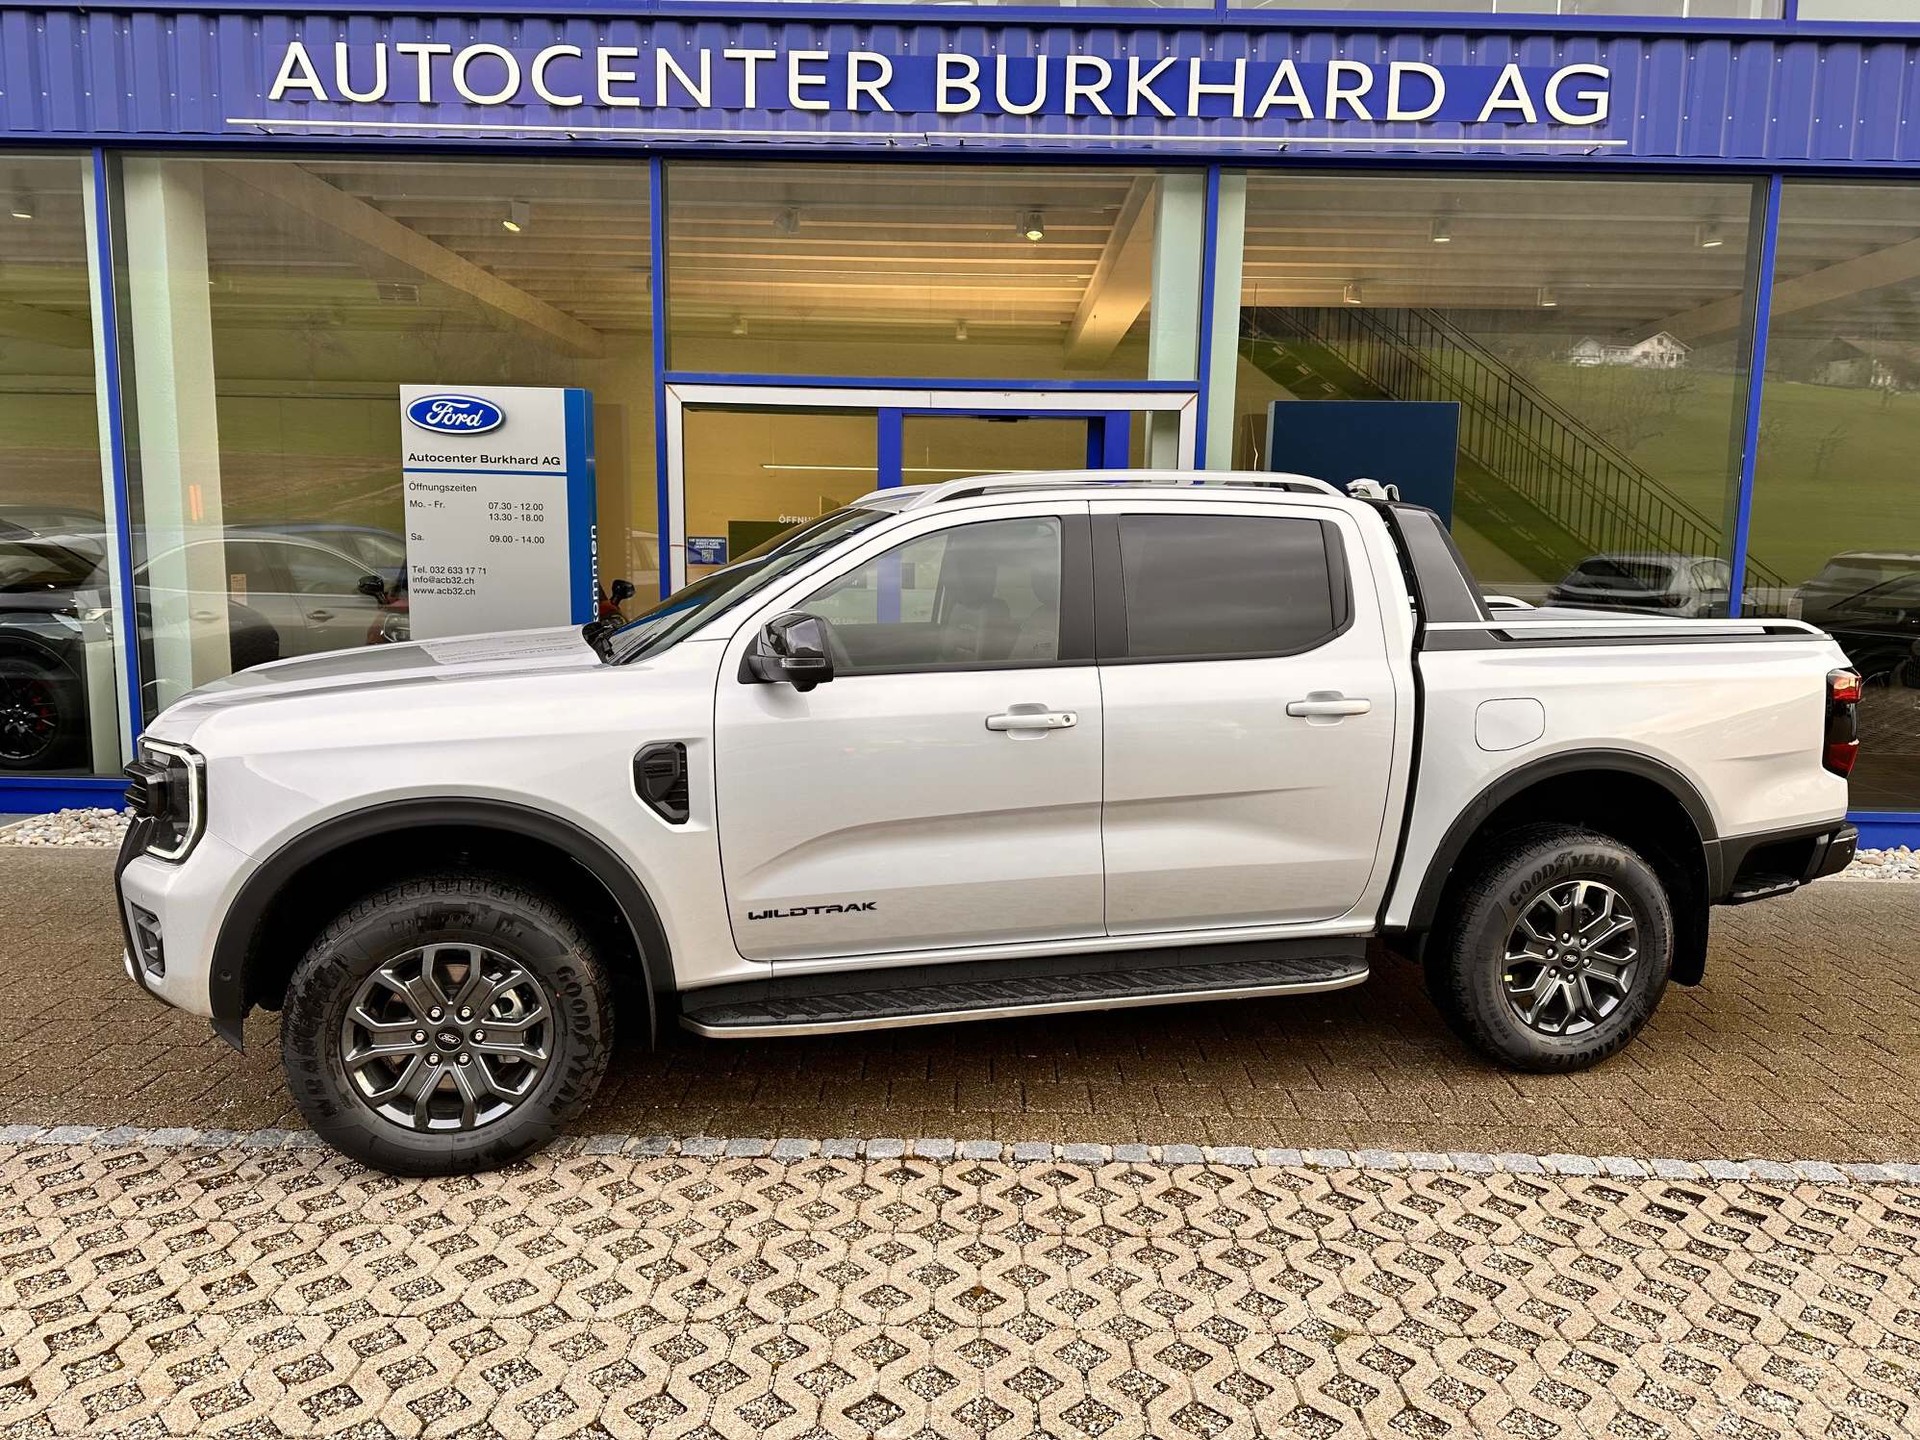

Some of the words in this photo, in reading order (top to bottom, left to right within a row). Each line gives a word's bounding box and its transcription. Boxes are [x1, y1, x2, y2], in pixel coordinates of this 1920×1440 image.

[267, 41, 896, 112] AUTOCENTER
[936, 53, 1447, 122] BURKHARD
[1476, 63, 1611, 126] AG
[425, 400, 483, 427] Ford
[408, 452, 478, 464] Autocenter
[480, 454, 538, 466] Burkhard
[542, 456, 561, 466] AG
[408, 481, 477, 494] Öffnungszeiten
[409, 500, 426, 509] Mo.
[433, 501, 446, 509] Fr.
[488, 502, 512, 511] 07.30
[520, 503, 544, 512] 12.00
[488, 513, 512, 522] 13.30
[521, 514, 545, 523] 18.00
[410, 532, 425, 542] Sa.
[489, 535, 513, 544] 09.00
[521, 536, 545, 545] 14.00
[412, 565, 428, 575] Tel.
[429, 566, 445, 575] 032
[447, 566, 463, 575] 633
[466, 567, 475, 575] 17
[477, 567, 487, 576] 71
[412, 576, 475, 586] info@acb32.ch
[412, 587, 476, 597] www.acb32.ch
[748, 902, 877, 920] WILDTRAK
